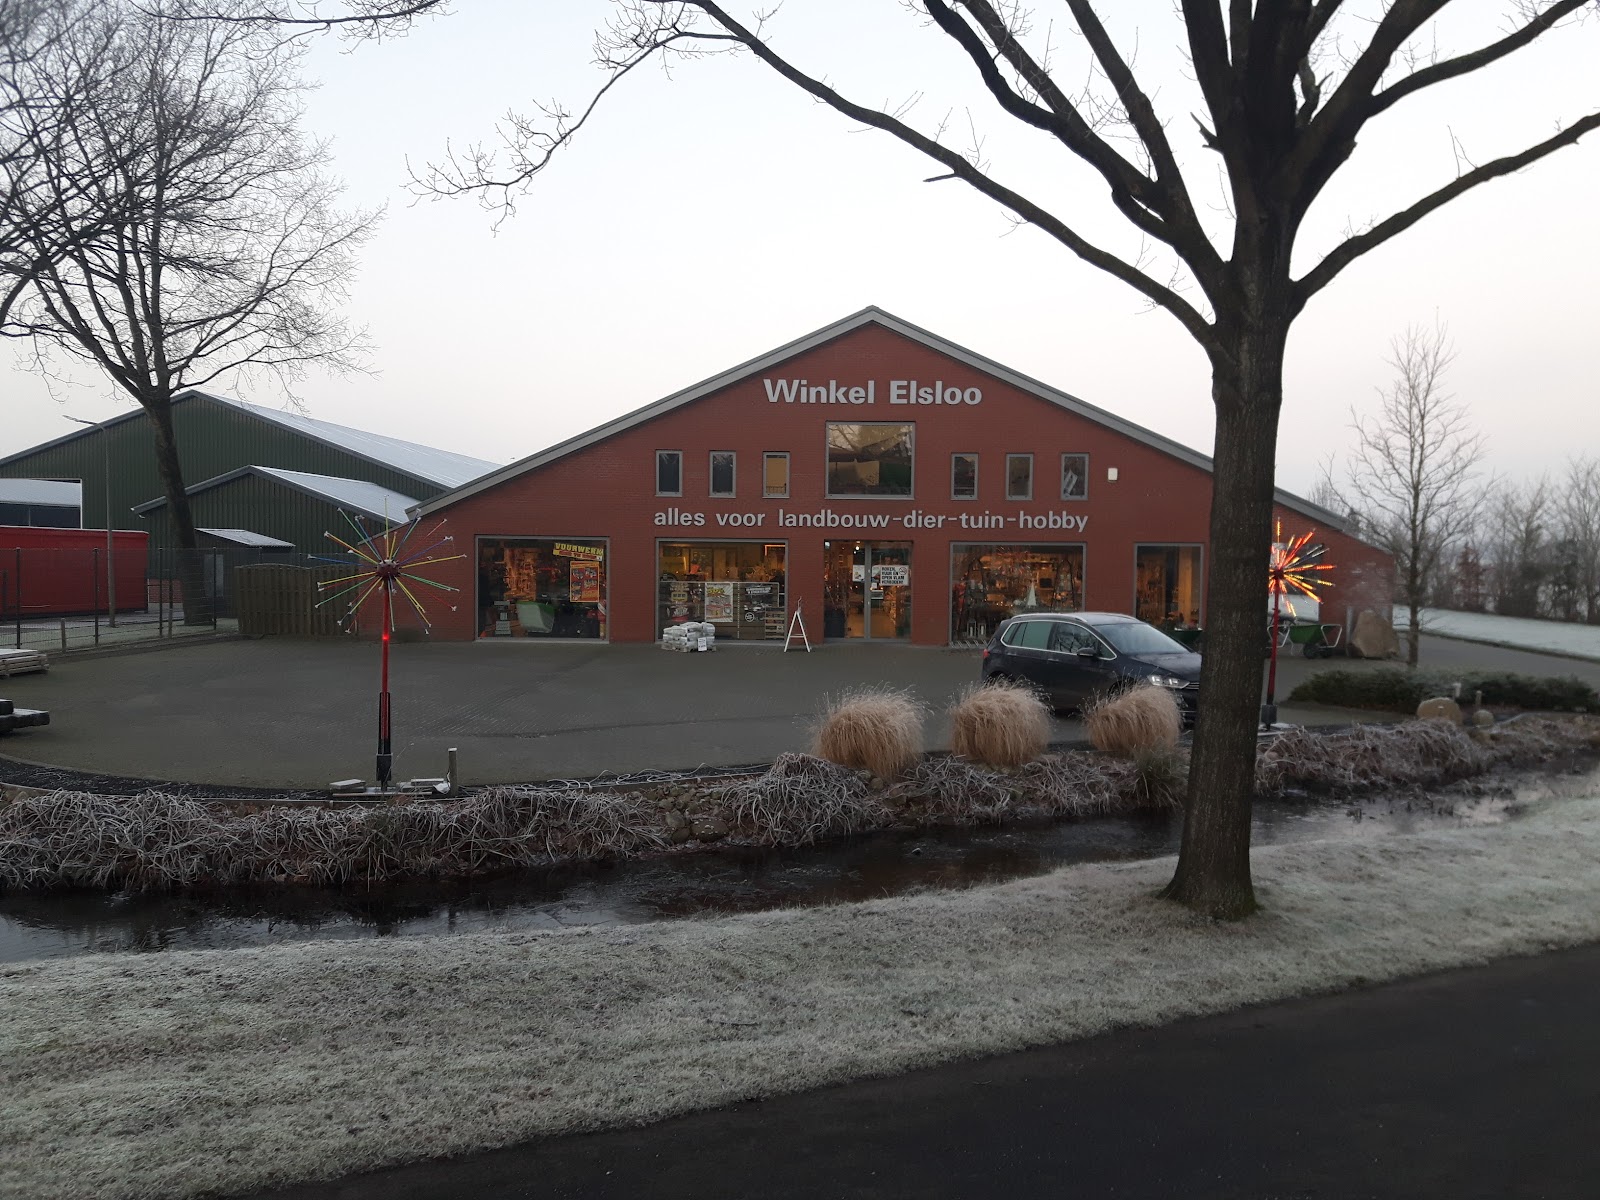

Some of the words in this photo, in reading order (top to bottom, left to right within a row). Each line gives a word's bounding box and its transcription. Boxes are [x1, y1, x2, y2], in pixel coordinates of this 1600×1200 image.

[763, 378, 875, 404] Winkel
[890, 380, 982, 405] Elsloo
[654, 507, 706, 526] alles
[716, 512, 765, 527] voor
